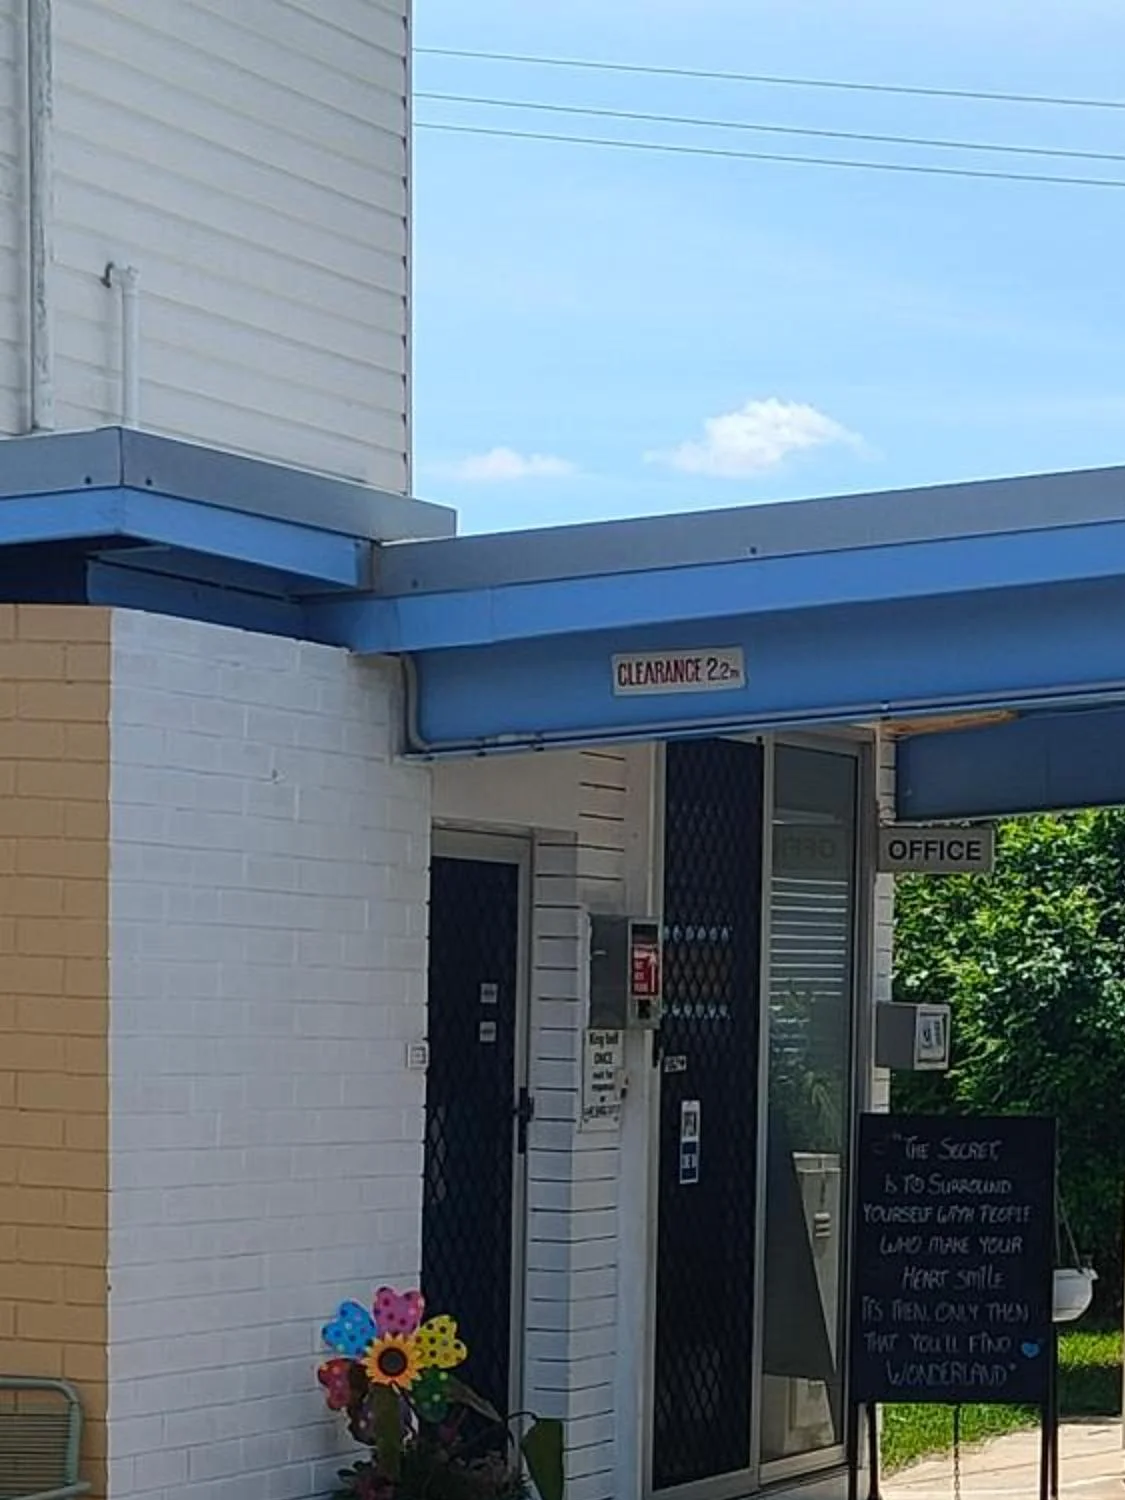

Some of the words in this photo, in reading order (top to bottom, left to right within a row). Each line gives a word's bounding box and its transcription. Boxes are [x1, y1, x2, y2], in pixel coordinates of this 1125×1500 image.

[617, 658, 702, 687] CLEARANCE
[888, 839, 982, 861] OFFICE
[903, 1174, 925, 1195] TO
[926, 1172, 1013, 1195] SURROUND
[863, 1203, 934, 1224] YOURSELF
[936, 1203, 975, 1225] WITH
[978, 1203, 1032, 1224] PEOPLE
[879, 1235, 922, 1255] WHO
[928, 1236, 970, 1255] MAKE
[979, 1235, 1024, 1255] YOUR
[901, 1265, 950, 1291] HEART
[934, 1302, 979, 1323] ONLY
[985, 1301, 1030, 1323] THEN
[864, 1332, 899, 1354] THAT
[968, 1331, 1012, 1354] FIND
